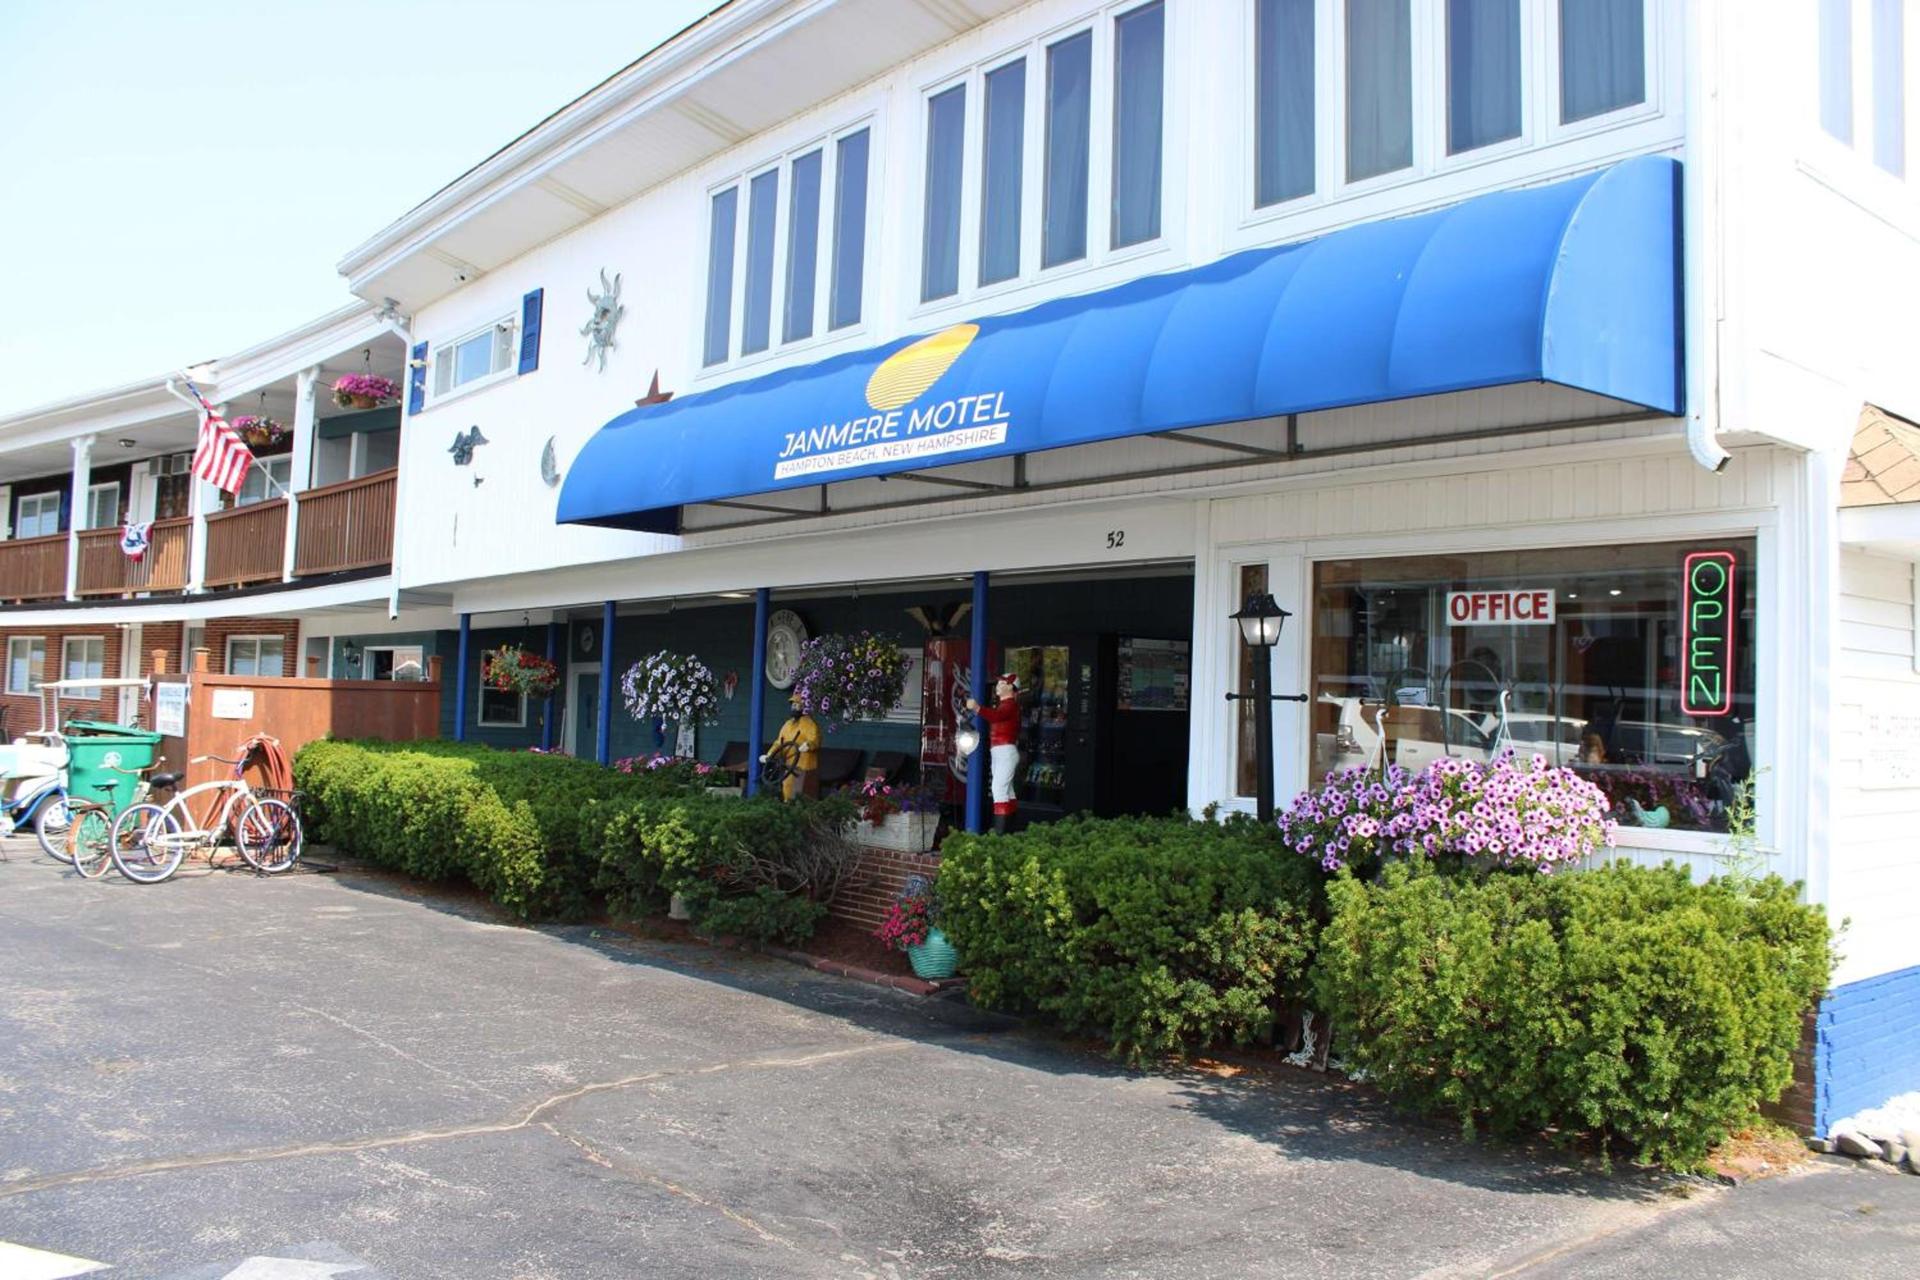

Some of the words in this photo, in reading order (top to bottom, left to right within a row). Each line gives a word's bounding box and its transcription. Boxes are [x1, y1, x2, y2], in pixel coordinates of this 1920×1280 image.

[779, 411, 902, 457] JANMERE
[907, 391, 1010, 435] MOTEL
[780, 456, 835, 474] HAMPTON
[837, 447, 879, 465] BEACH,
[882, 443, 914, 457] NEW
[917, 426, 999, 452] HAMPSHIRE
[1106, 530, 1124, 549] 52
[1450, 592, 1549, 622] OFFICE
[1690, 561, 1726, 706] OPEN
